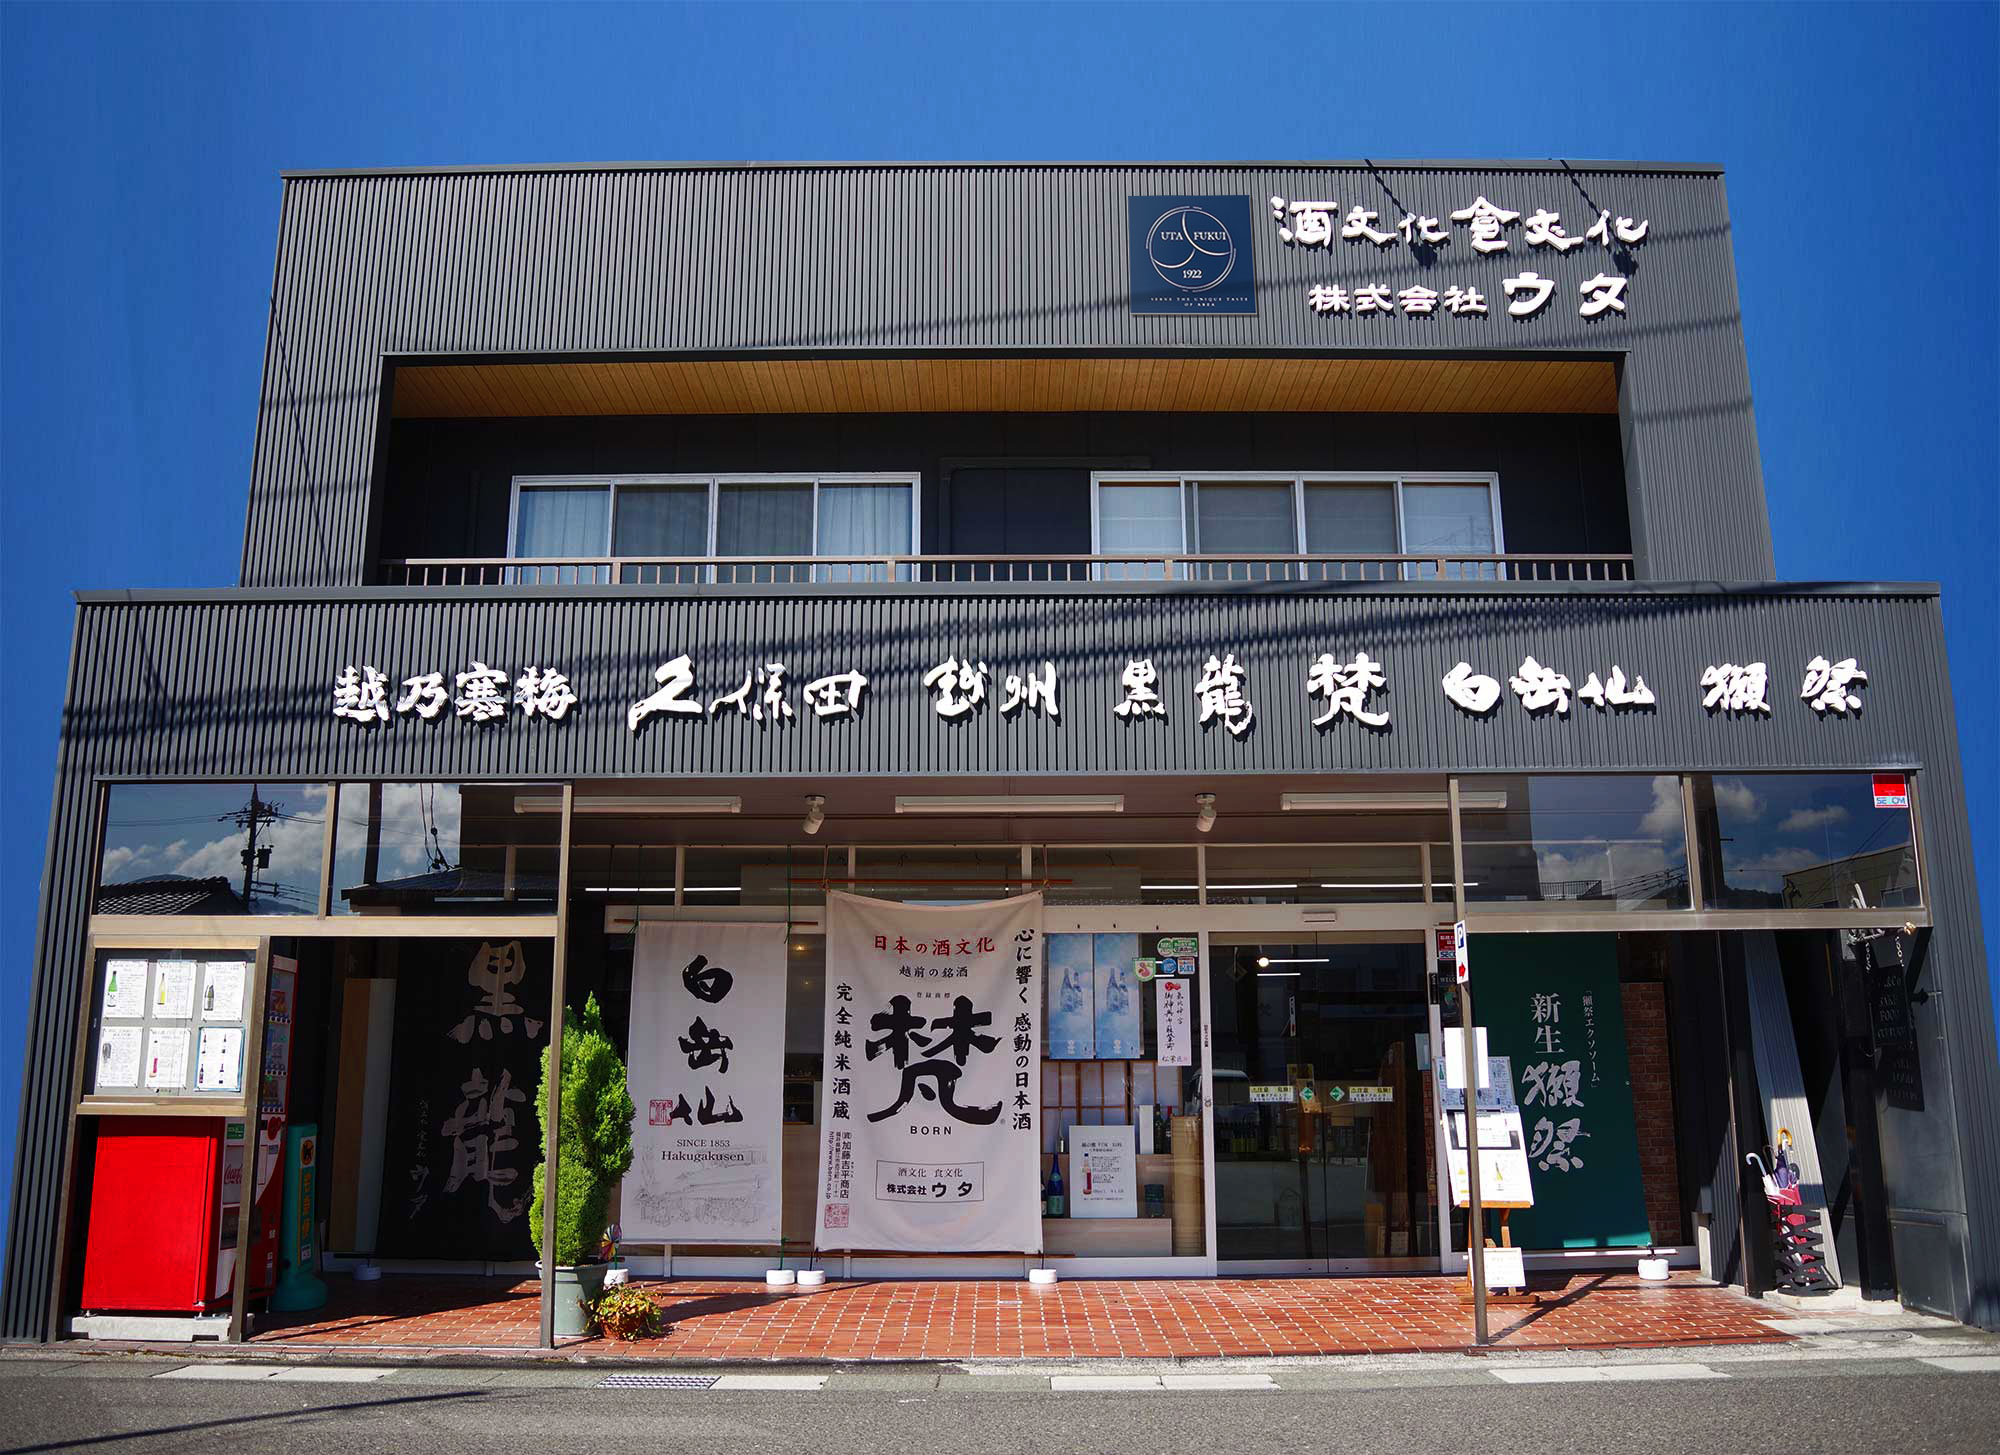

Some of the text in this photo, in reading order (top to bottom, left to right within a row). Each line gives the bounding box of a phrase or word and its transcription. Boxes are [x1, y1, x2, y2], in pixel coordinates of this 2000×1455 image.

[1270, 195, 1649, 253] 酒文化食文化
[1160, 231, 1227, 241] UTA FUKUI
[1182, 269, 1203, 279] 1922
[1308, 272, 1630, 318] 株式会社 ウタ
[332, 660, 578, 724] 越乃寒梅
[627, 654, 870, 732] 久保田
[1113, 652, 1253, 735] 黒龍
[1307, 650, 1390, 728] 梵
[1702, 654, 1868, 714] 獺祭
[873, 933, 997, 957] 日本の酒文化
[898, 964, 969, 979] 越前の銘酒
[831, 981, 854, 1121] 完全純米酒蔵
[864, 993, 1004, 1127] 梵
[441, 940, 545, 1225] 黒龍
[1521, 992, 1592, 1174] 新生 獺祭
[909, 1124, 953, 1136] BORN
[676, 1139, 731, 1148] SINCE 1853
[661, 1150, 745, 1163] Hakugakusen
[897, 1166, 963, 1178] 酒文化 食文化
[886, 1182, 974, 1198] 株式会社 ウタ
